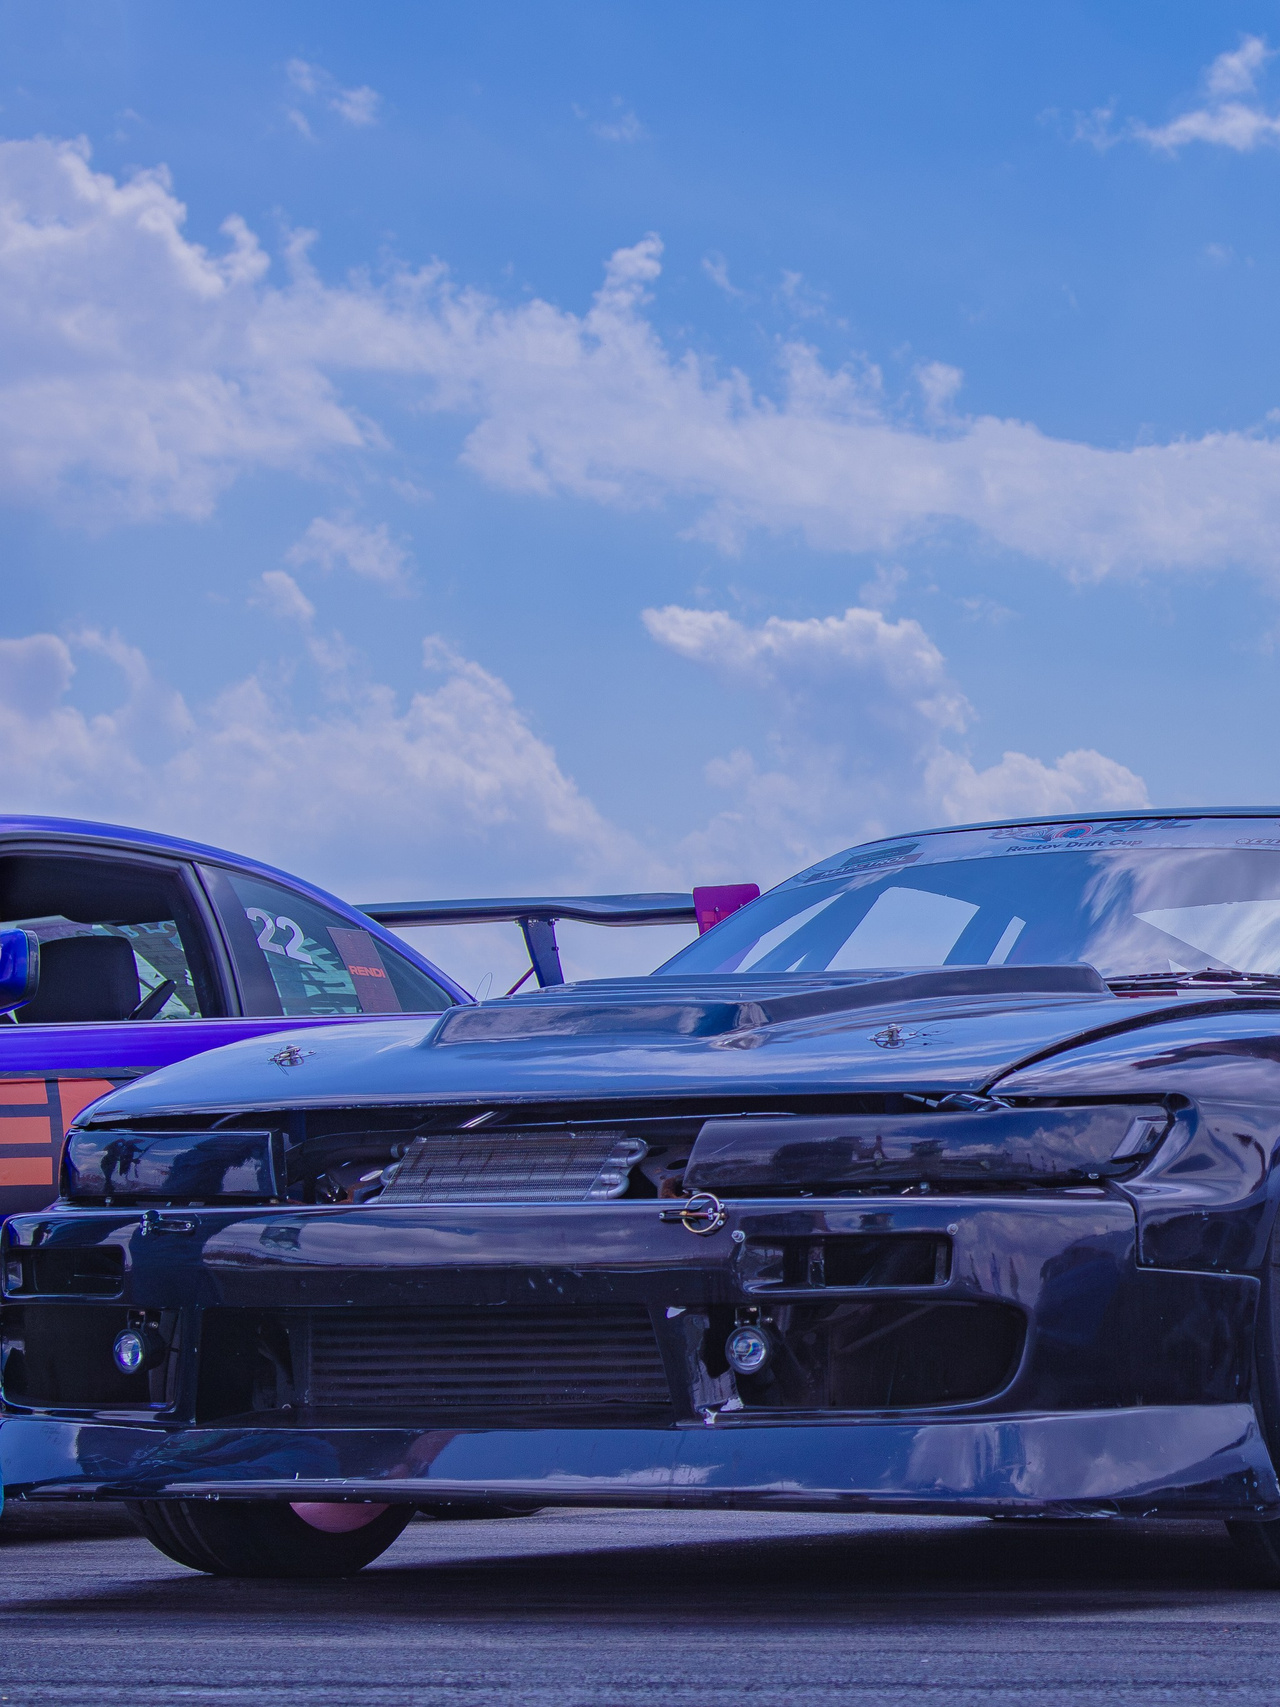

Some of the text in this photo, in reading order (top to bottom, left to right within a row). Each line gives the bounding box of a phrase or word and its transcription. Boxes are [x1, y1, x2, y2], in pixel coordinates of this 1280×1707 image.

[1006, 839, 1143, 852] Rostov Drift Cup
[246, 907, 313, 965] 22
[348, 965, 386, 978] RENDI
